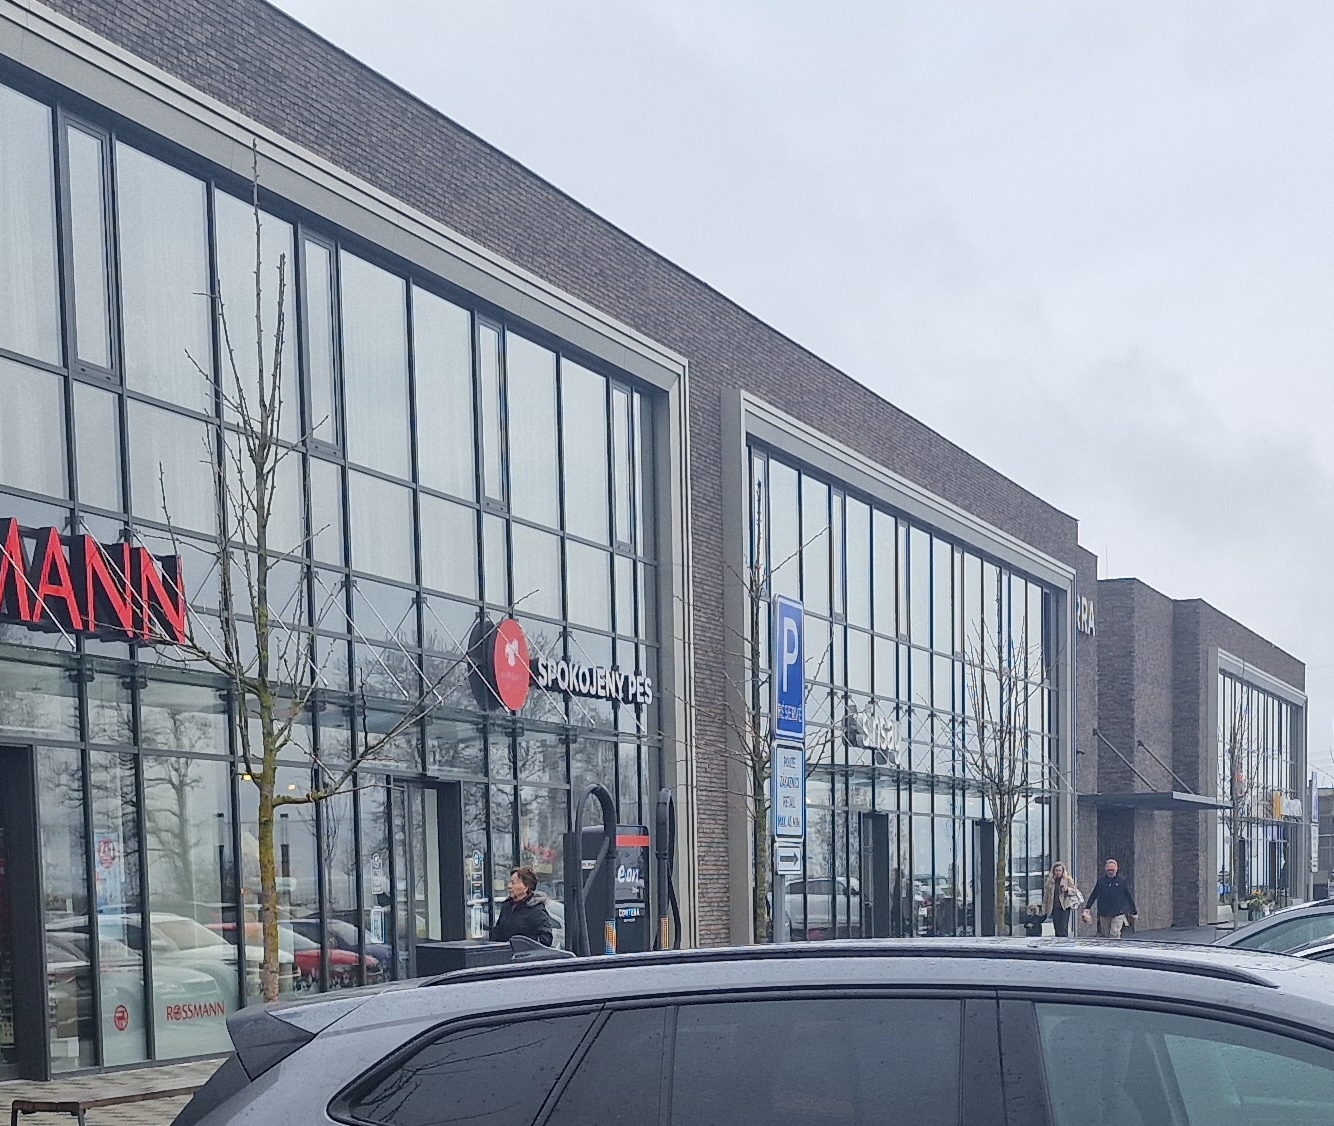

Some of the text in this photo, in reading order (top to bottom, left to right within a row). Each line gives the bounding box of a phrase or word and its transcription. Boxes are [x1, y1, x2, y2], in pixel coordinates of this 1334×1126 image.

[782, 616, 799, 693] P
[628, 674, 653, 705] PES
[166, 1001, 225, 1021] ROSSMANN
